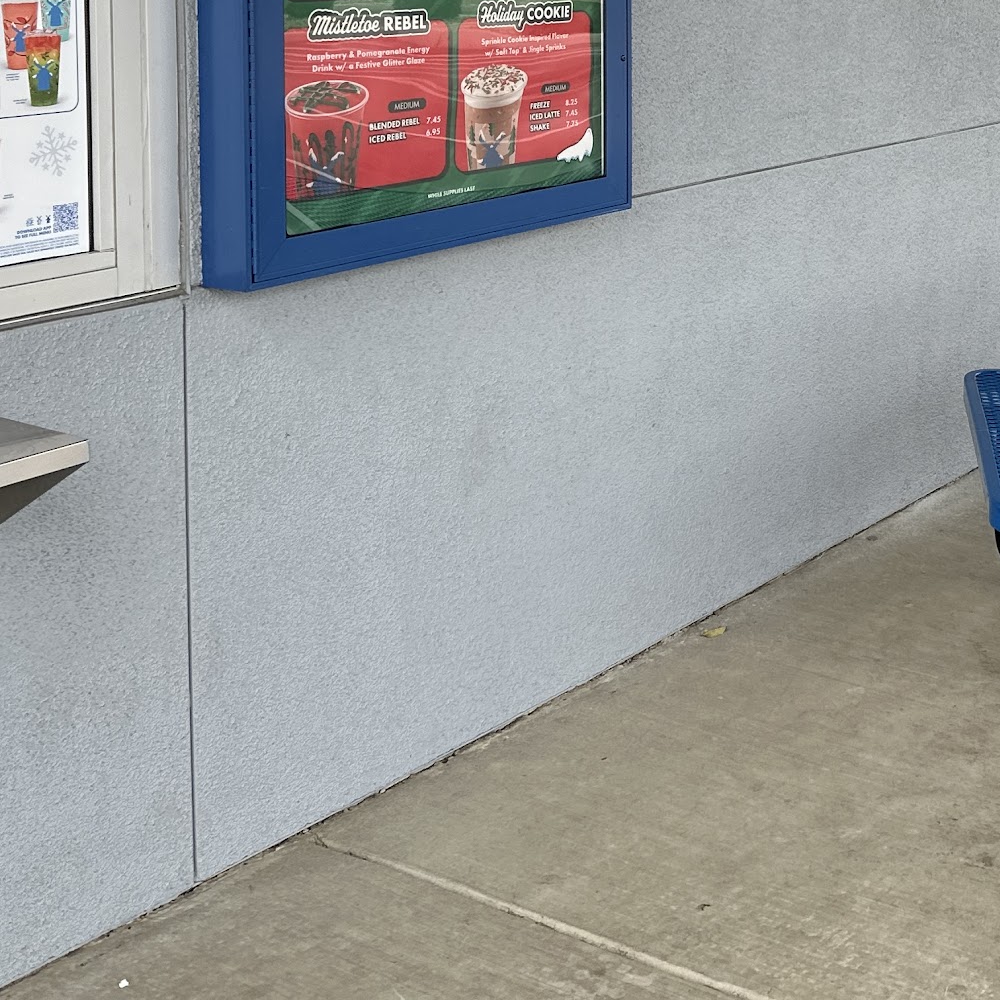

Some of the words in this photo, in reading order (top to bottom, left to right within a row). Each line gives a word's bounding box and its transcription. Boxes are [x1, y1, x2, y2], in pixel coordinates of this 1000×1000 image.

[480, 4, 525, 28] Holiday
[526, 5, 571, 21] COOKIE
[312, 13, 381, 36] Mistletoe
[383, 14, 427, 32] REBEL
[481, 36, 507, 47] Sprinkle
[507, 34, 529, 44] Cookie
[306, 51, 348, 63] Raspberry
[349, 50, 356, 59] &
[357, 47, 406, 59] Pomegranate
[406, 46, 431, 56] Energy
[485, 49, 495, 58] w/
[495, 47, 508, 56] Soft
[522, 46, 528, 54] &
[311, 63, 334, 73] Drink
[335, 62, 347, 72] w/
[355, 59, 382, 69] Festive
[382, 57, 405, 67] Glitter
[406, 56, 426, 65] Glaze
[544, 84, 567, 93] MEDIUM
[394, 101, 420, 110] MEDIUM
[529, 101, 551, 110] FREEZE
[529, 112, 544, 121] ICED
[543, 110, 561, 120] LATTE
[566, 109, 578, 118] 7.45
[369, 120, 402, 131] BLENDED
[401, 117, 420, 127] REBEL
[426, 115, 441, 125] 7.45
[425, 127, 441, 137] 6.95
[529, 122, 550, 132] SHAKE
[369, 134, 387, 144] ICED
[386, 131, 407, 141] REBEL
[463, 185, 476, 193] LAST
